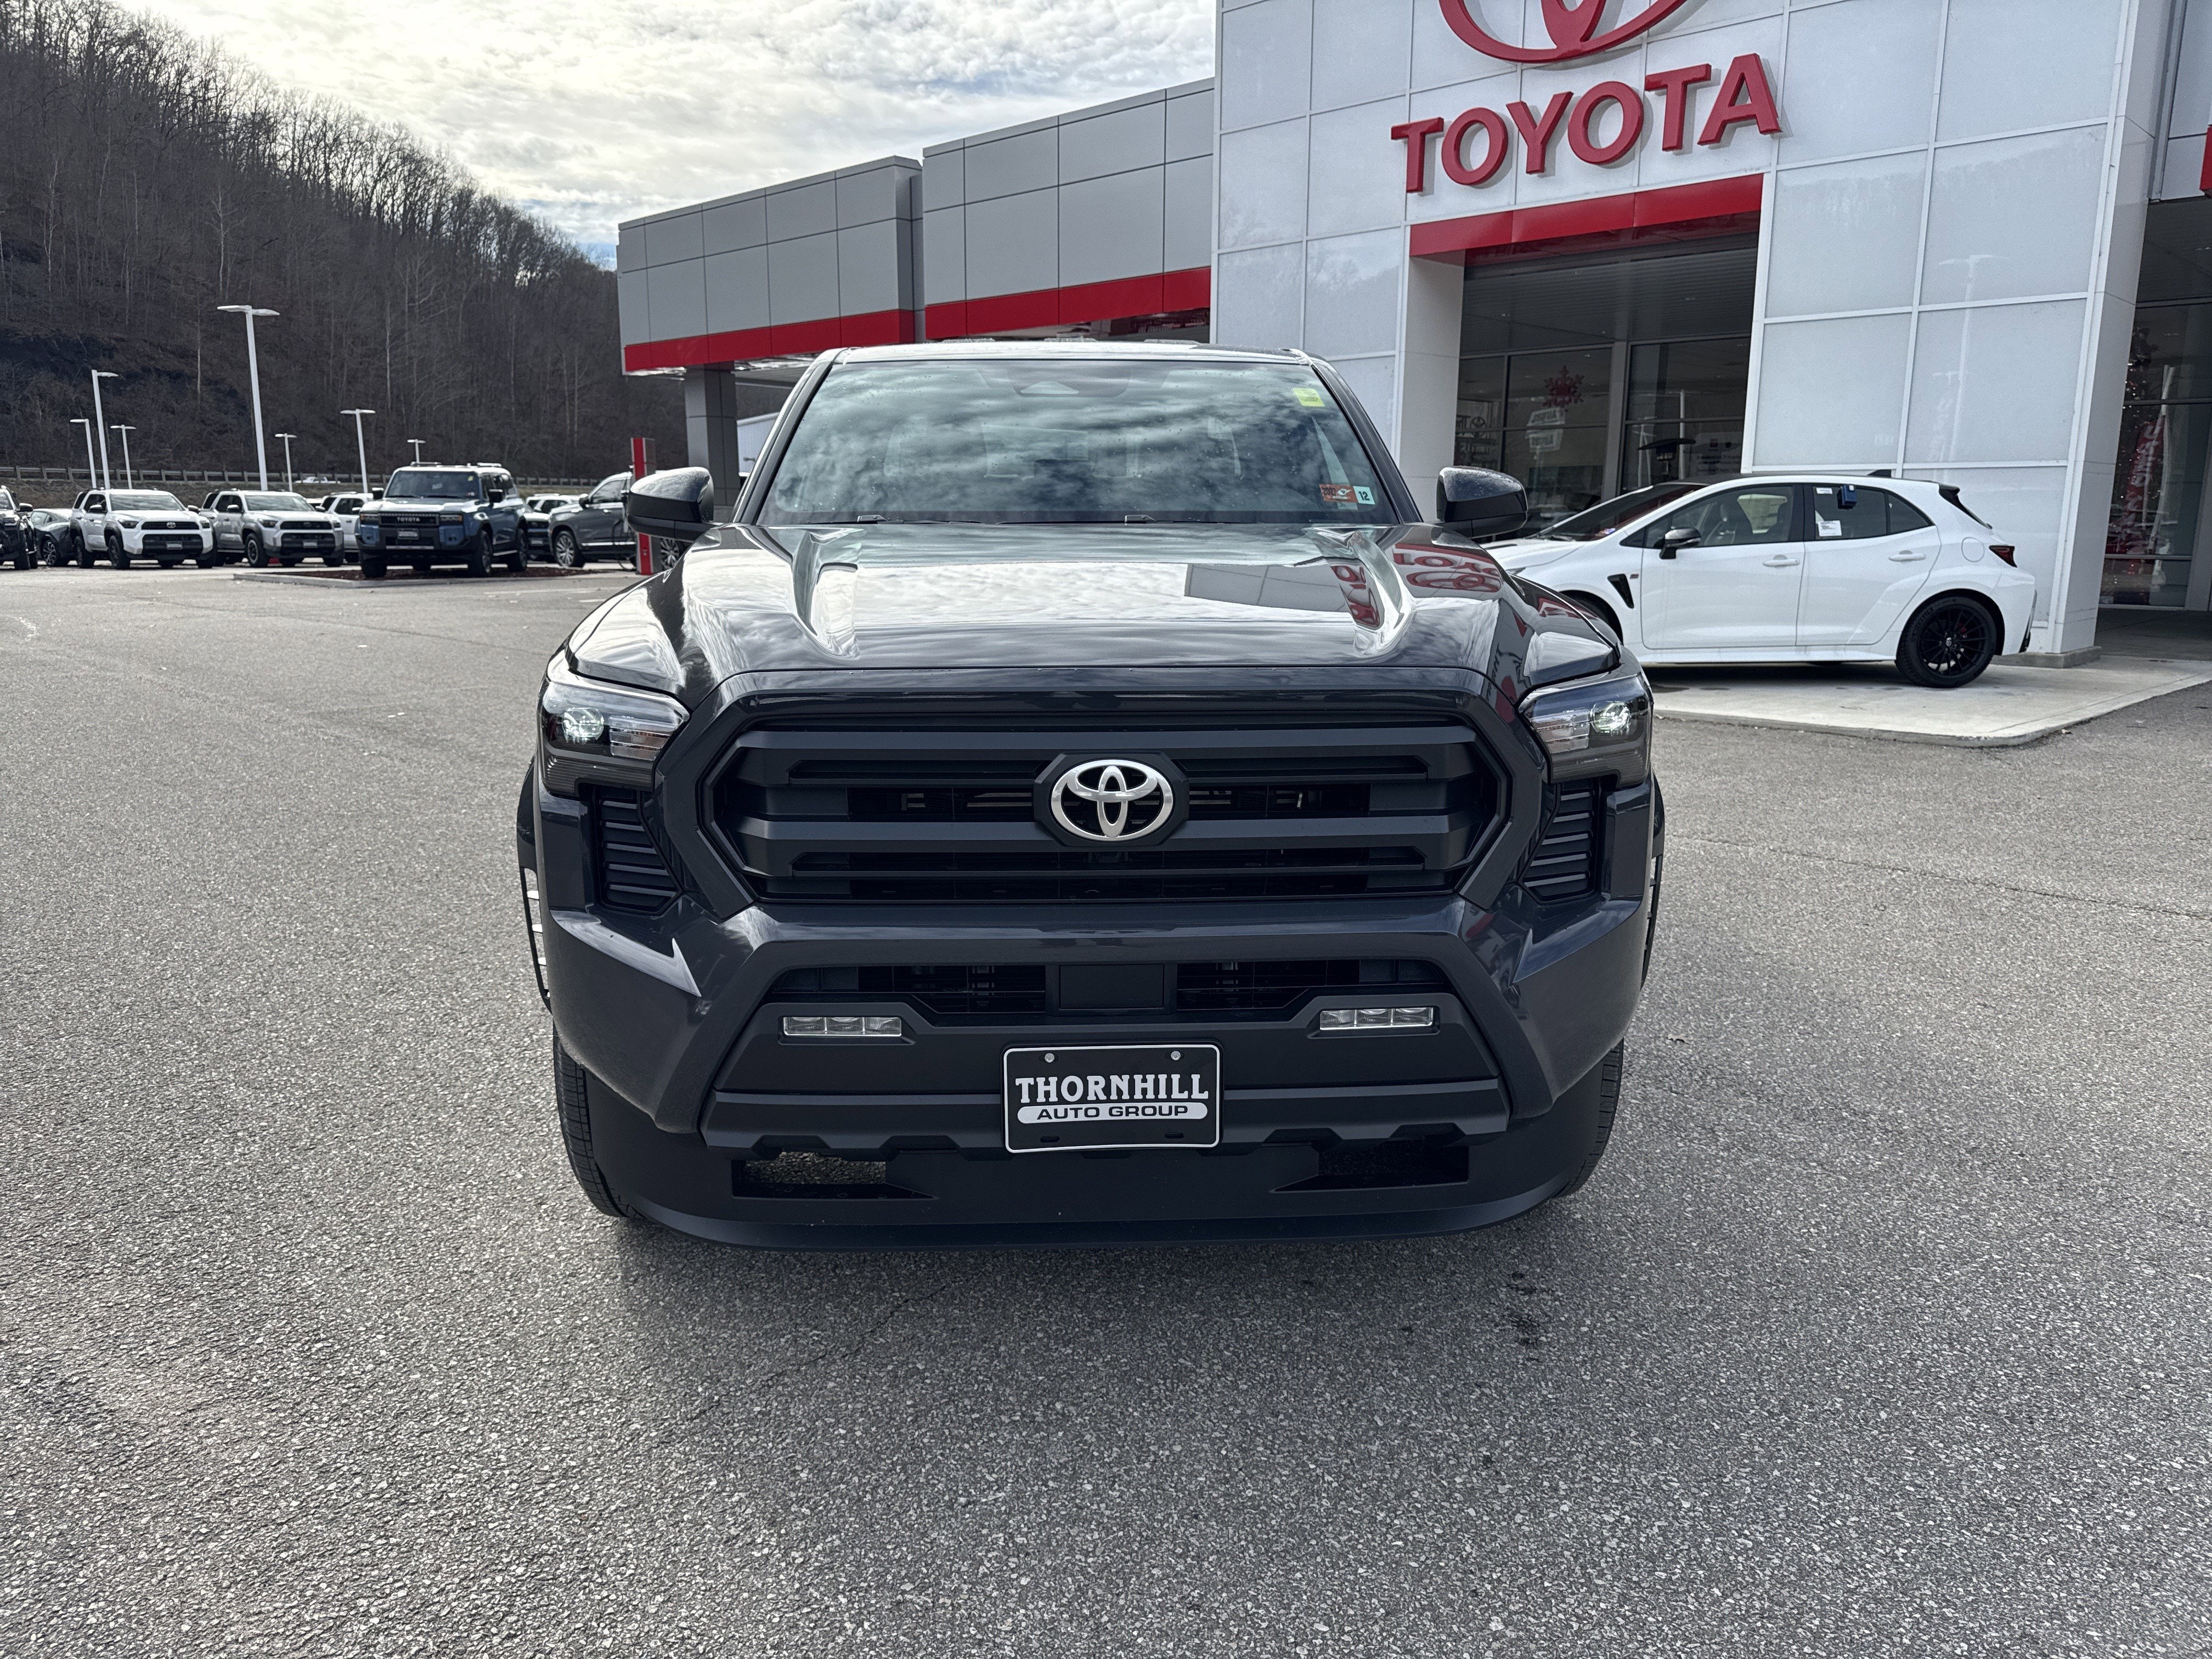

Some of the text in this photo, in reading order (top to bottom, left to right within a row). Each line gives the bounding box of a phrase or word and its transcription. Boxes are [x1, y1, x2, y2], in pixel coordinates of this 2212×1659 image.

[1391, 53, 1782, 193] TOYOTA
[1358, 491, 1370, 501] 12
[1015, 1074, 1209, 1103] THORNHILL
[1037, 1105, 1188, 1120] AUTO GROUP
